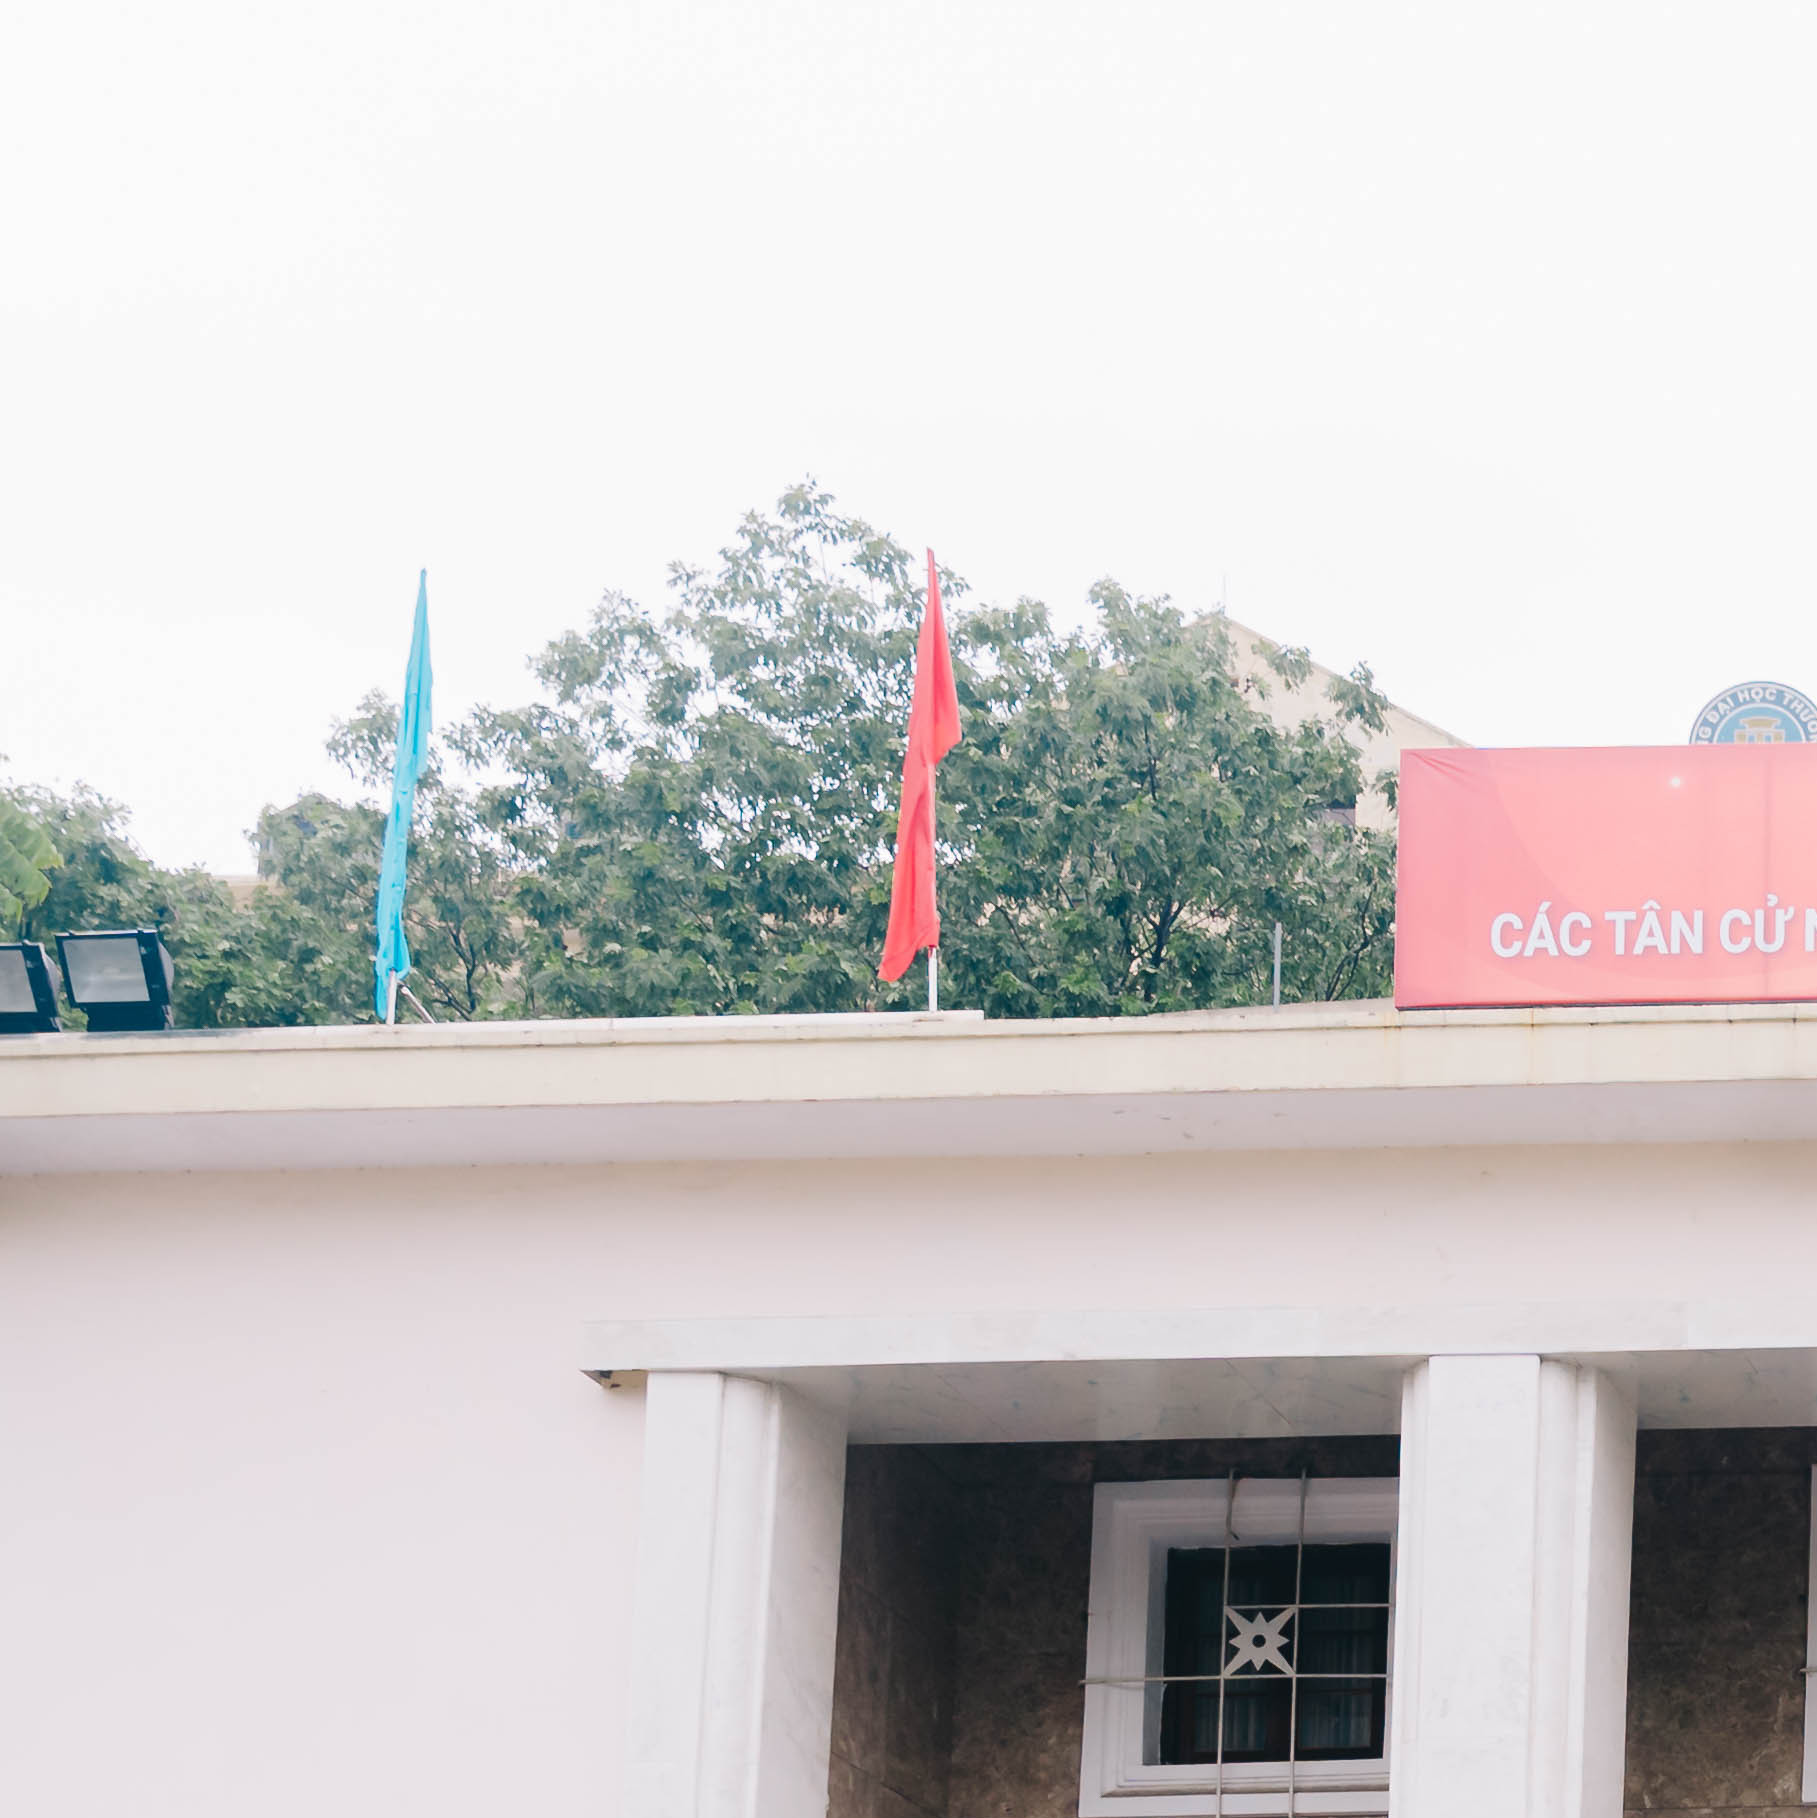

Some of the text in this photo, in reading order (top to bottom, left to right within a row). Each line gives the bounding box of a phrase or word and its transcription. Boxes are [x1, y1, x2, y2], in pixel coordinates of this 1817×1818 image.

[1705, 697, 1736, 724] ĐẠI
[1737, 687, 1777, 703] HỌC
[1491, 898, 1591, 957] CÁC
[1605, 899, 1703, 955] TÂN
[1720, 893, 1794, 954] CỬ
